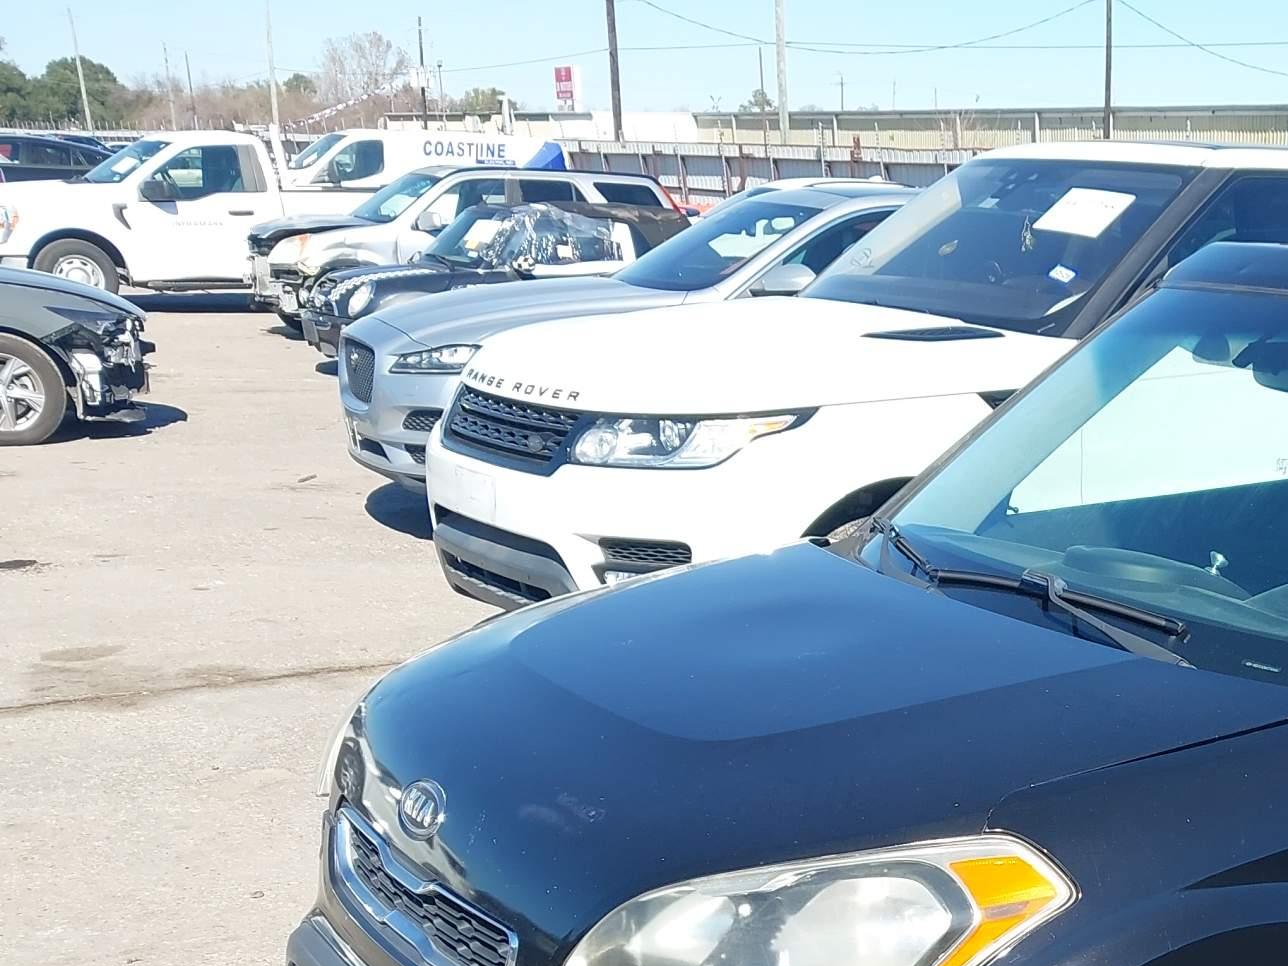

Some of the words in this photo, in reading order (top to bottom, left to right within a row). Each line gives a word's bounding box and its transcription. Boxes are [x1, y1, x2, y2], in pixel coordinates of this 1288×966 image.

[467, 368, 504, 388] RANGE
[512, 382, 580, 402] ROVER
[404, 788, 435, 827] KIA
